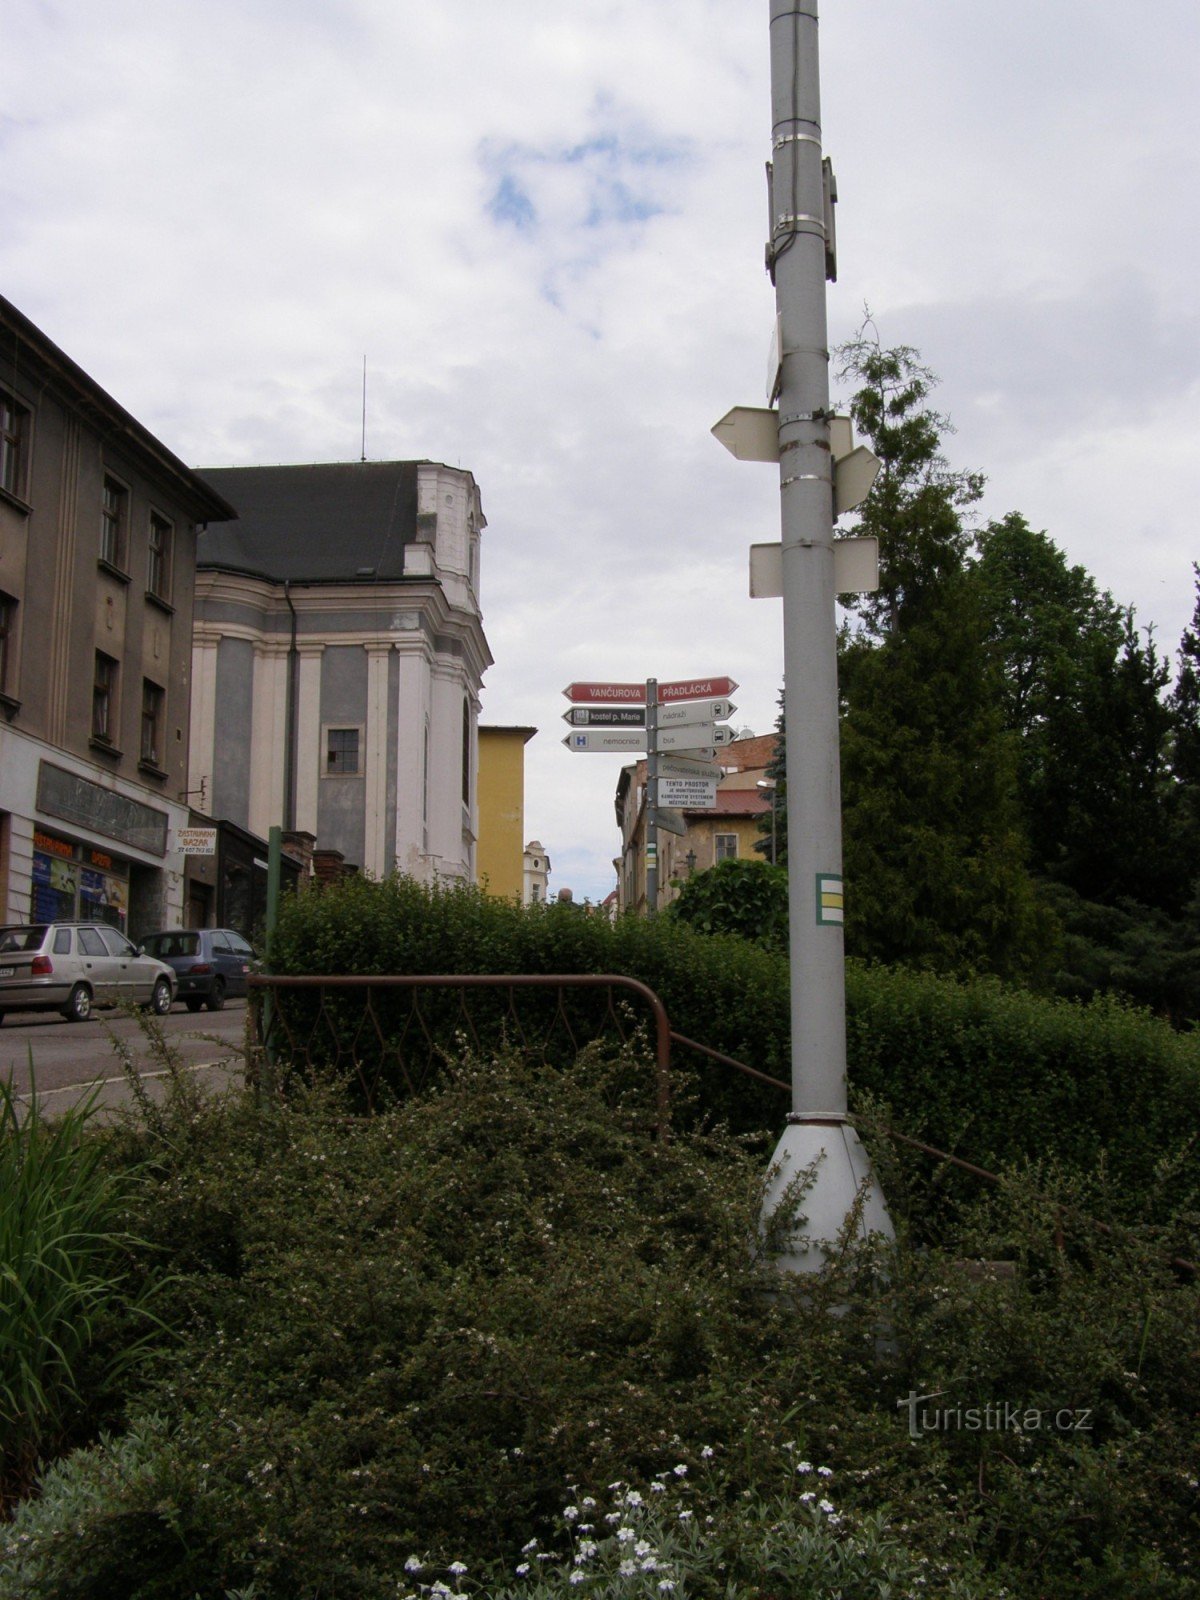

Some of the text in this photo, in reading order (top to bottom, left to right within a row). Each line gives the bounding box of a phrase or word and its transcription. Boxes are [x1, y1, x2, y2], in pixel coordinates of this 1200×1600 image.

[590, 686, 641, 698] VANČUROVA
[662, 683, 712, 697] PŘADLÁCKÁ
[590, 712, 641, 723] kostel p. Marie
[662, 709, 687, 720] nádraží
[603, 738, 640, 746] nemocnice
[183, 838, 209, 847] BAZAR
